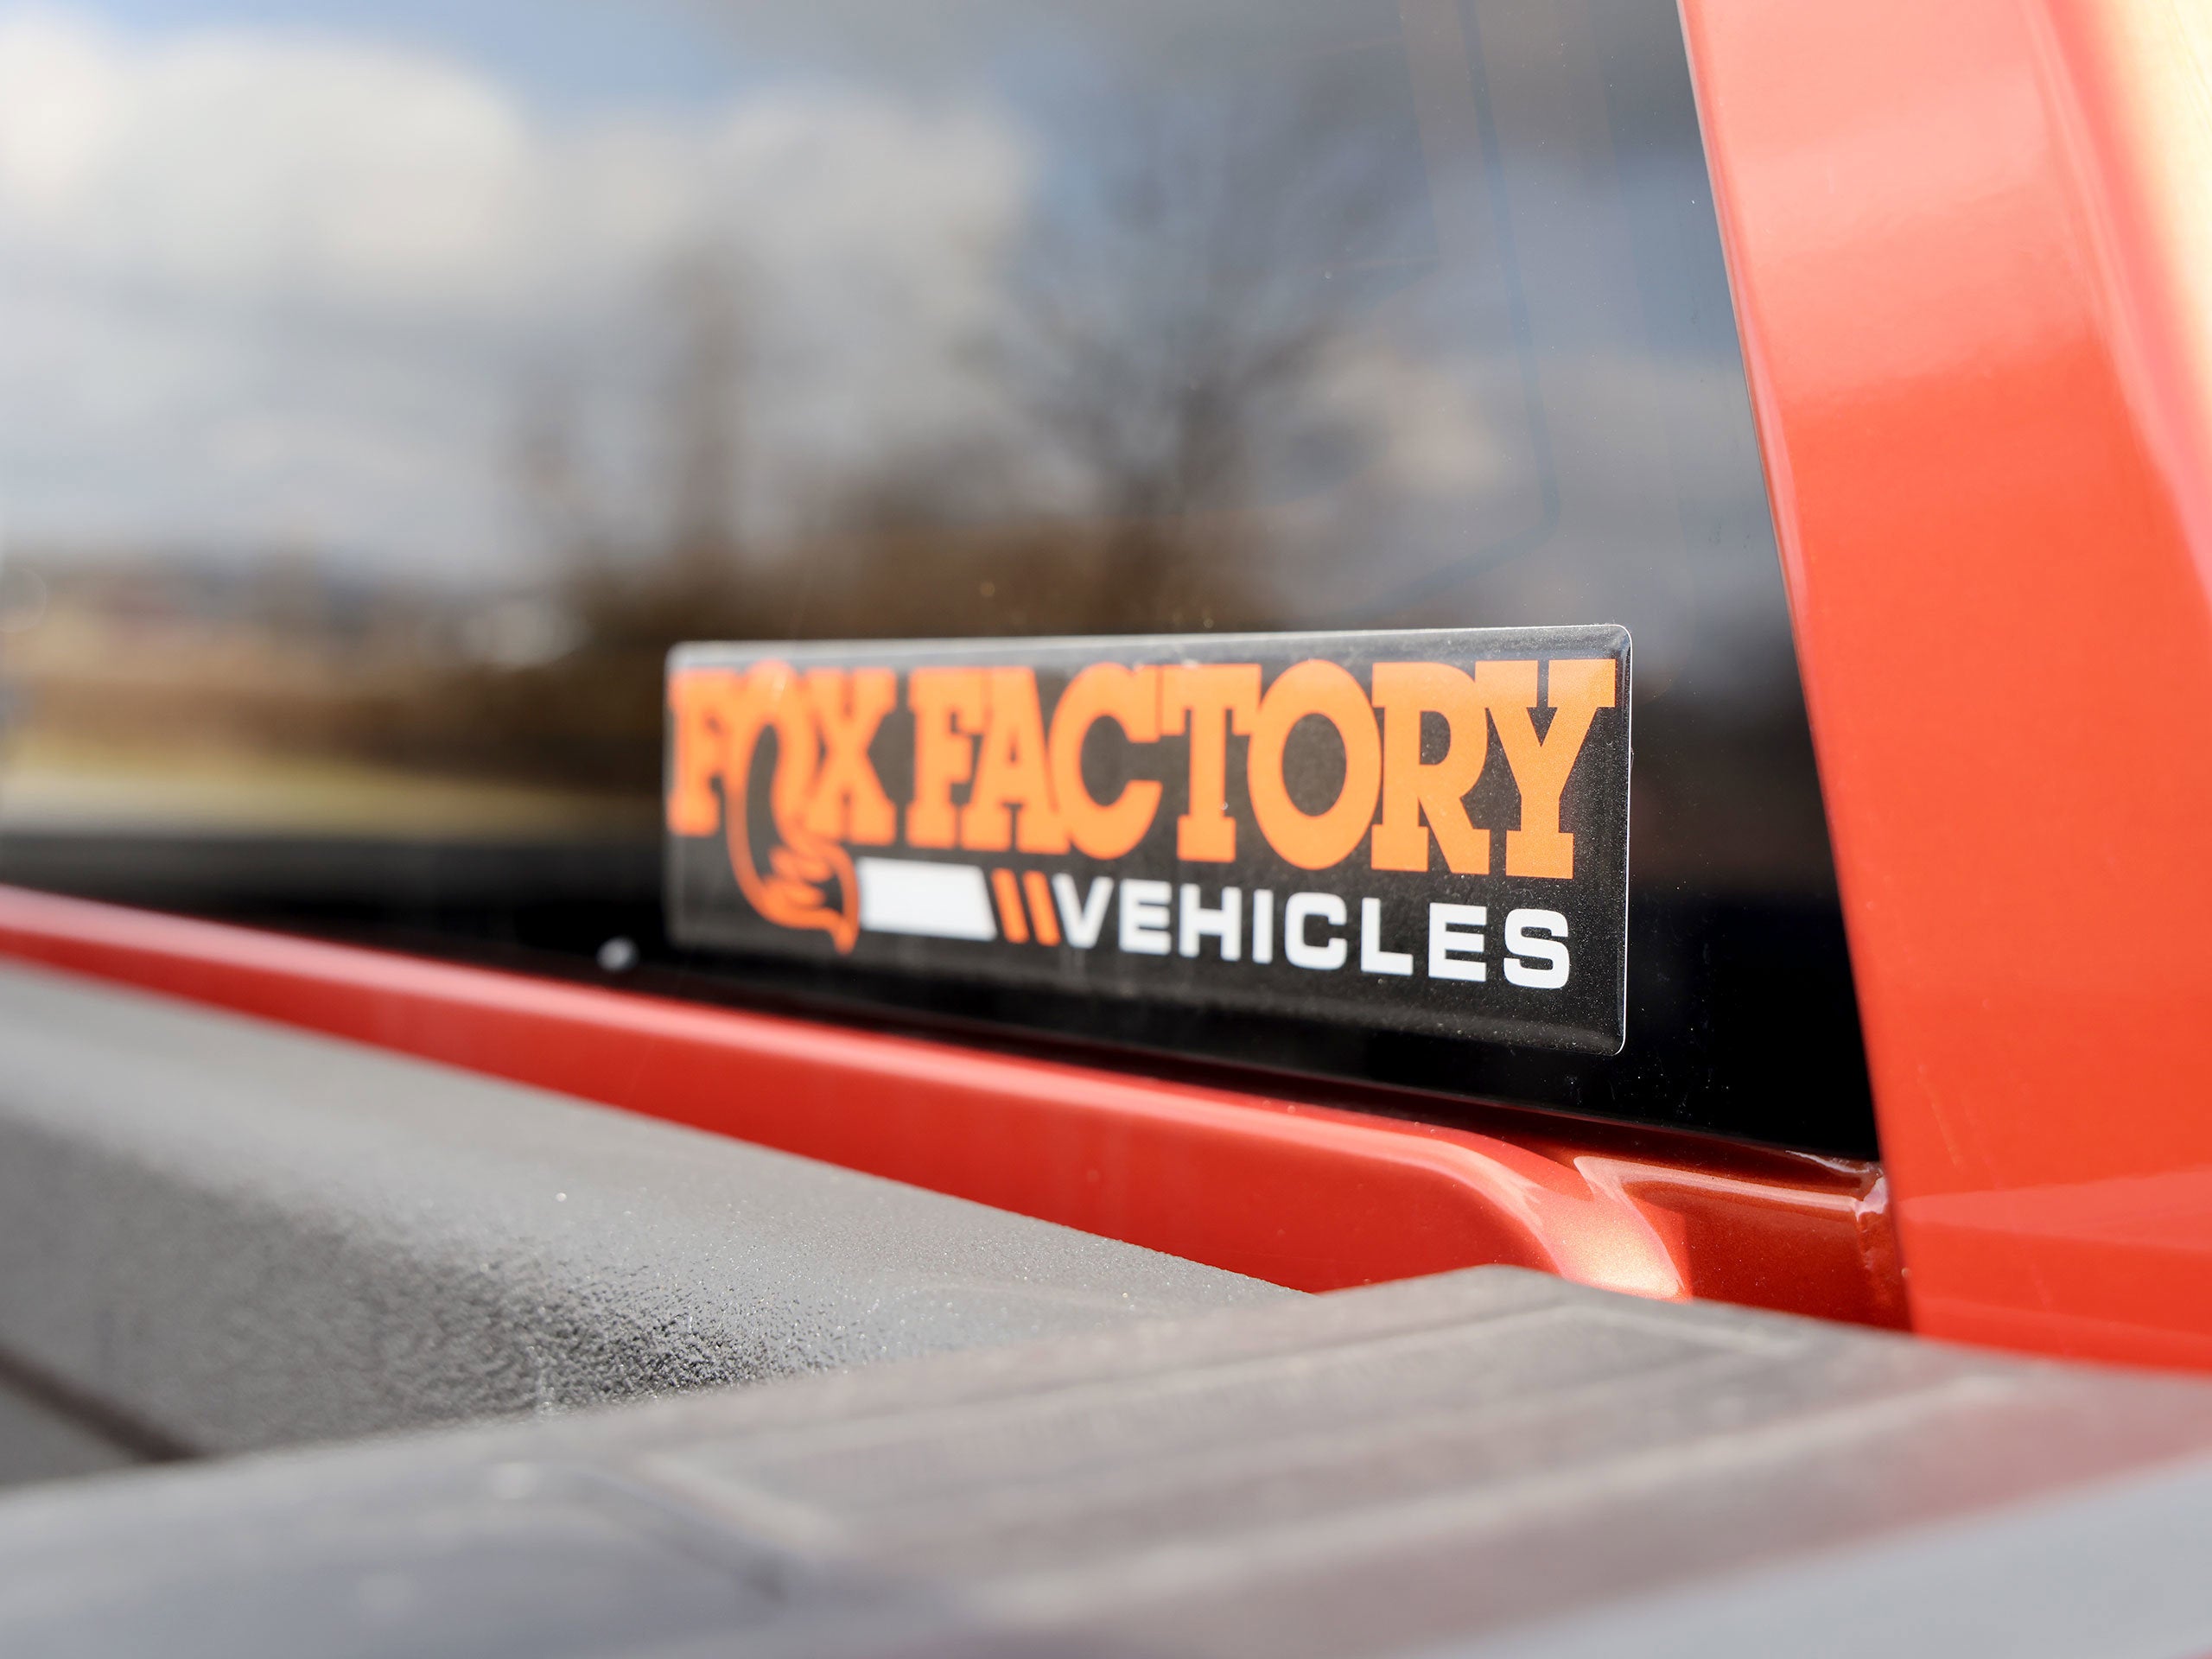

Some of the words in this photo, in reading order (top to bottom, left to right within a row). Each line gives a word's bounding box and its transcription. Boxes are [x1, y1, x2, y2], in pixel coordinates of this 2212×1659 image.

[668, 659, 897, 952] FOX
[906, 658, 1617, 880] FACTORY
[1052, 873, 1572, 989] VEHICLES
